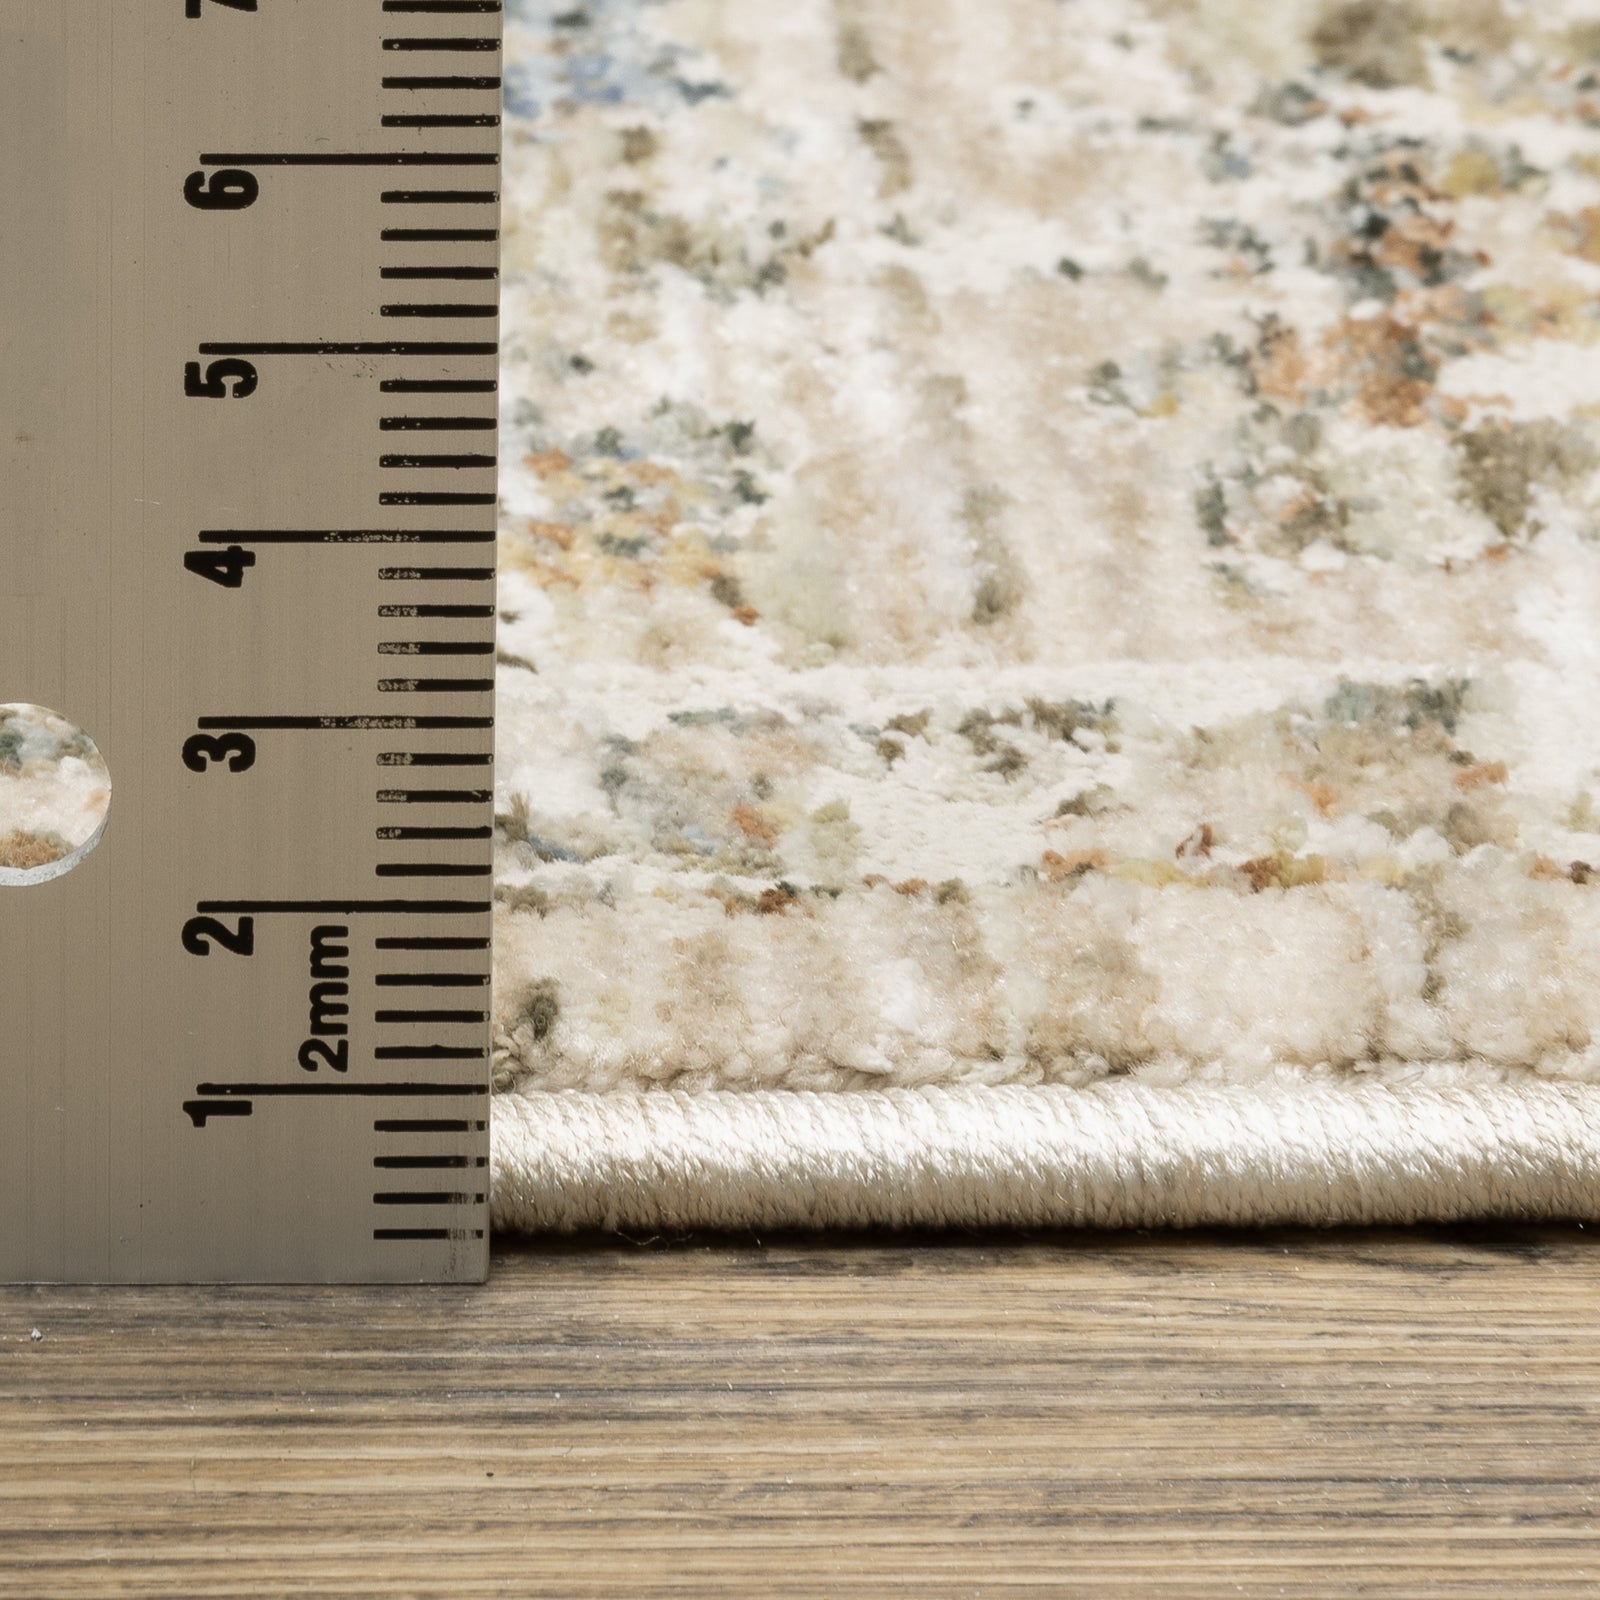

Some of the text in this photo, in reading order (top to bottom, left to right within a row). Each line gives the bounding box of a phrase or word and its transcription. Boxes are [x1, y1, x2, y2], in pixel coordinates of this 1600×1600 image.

[184, 169, 258, 211] 6
[183, 357, 259, 399] 5
[183, 546, 256, 588] 4
[182, 732, 256, 773] 3
[181, 916, 255, 957] 2
[297, 925, 350, 1073] 2mm
[182, 1099, 253, 1128] 1
